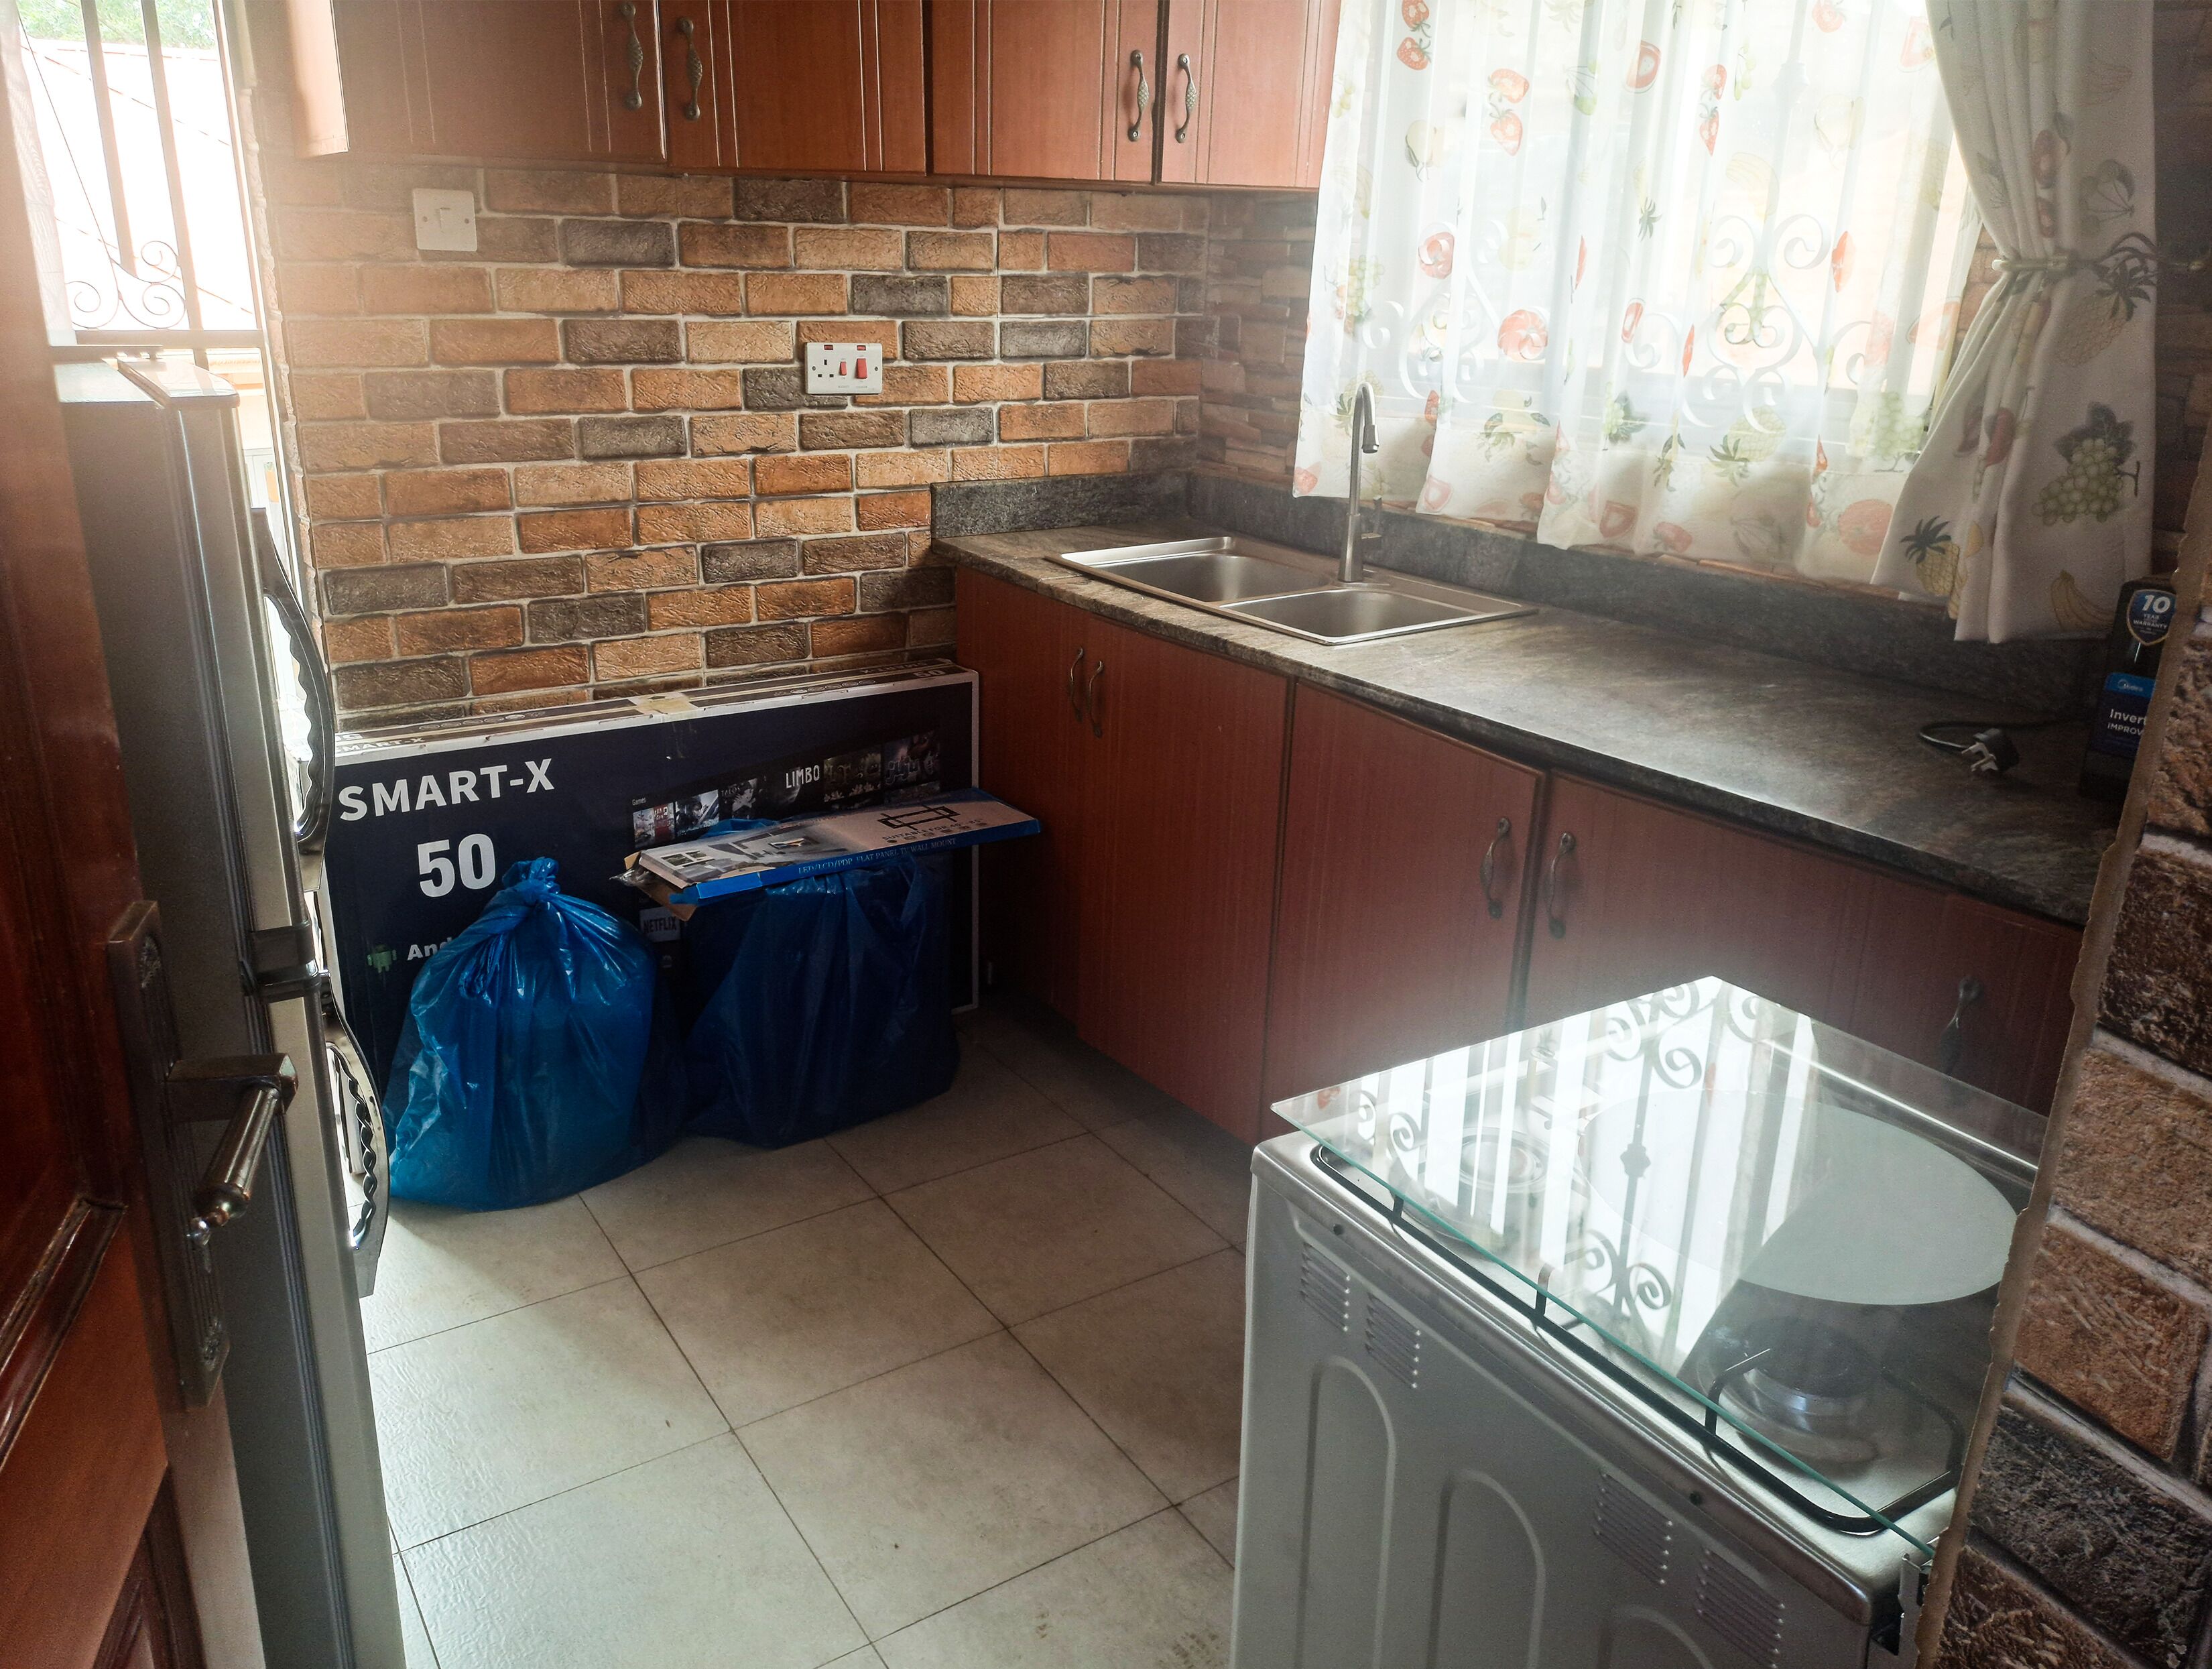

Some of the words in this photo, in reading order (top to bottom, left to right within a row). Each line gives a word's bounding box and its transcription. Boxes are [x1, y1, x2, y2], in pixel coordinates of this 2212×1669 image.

[2141, 594, 2171, 613] 10
[2133, 619, 2168, 629] WARRANTY
[913, 669, 946, 678] 50
[785, 764, 820, 789] LIMBO
[339, 758, 556, 822] SMART-X
[882, 828, 926, 841] SUITABLE
[856, 853, 875, 865] FLAT
[875, 849, 900, 860] PANEL
[900, 846, 910, 855] TV
[910, 843, 928, 853] WALL
[930, 838, 957, 849] MOUNT
[417, 833, 497, 898] 50
[643, 916, 676, 934] NETFLIX
